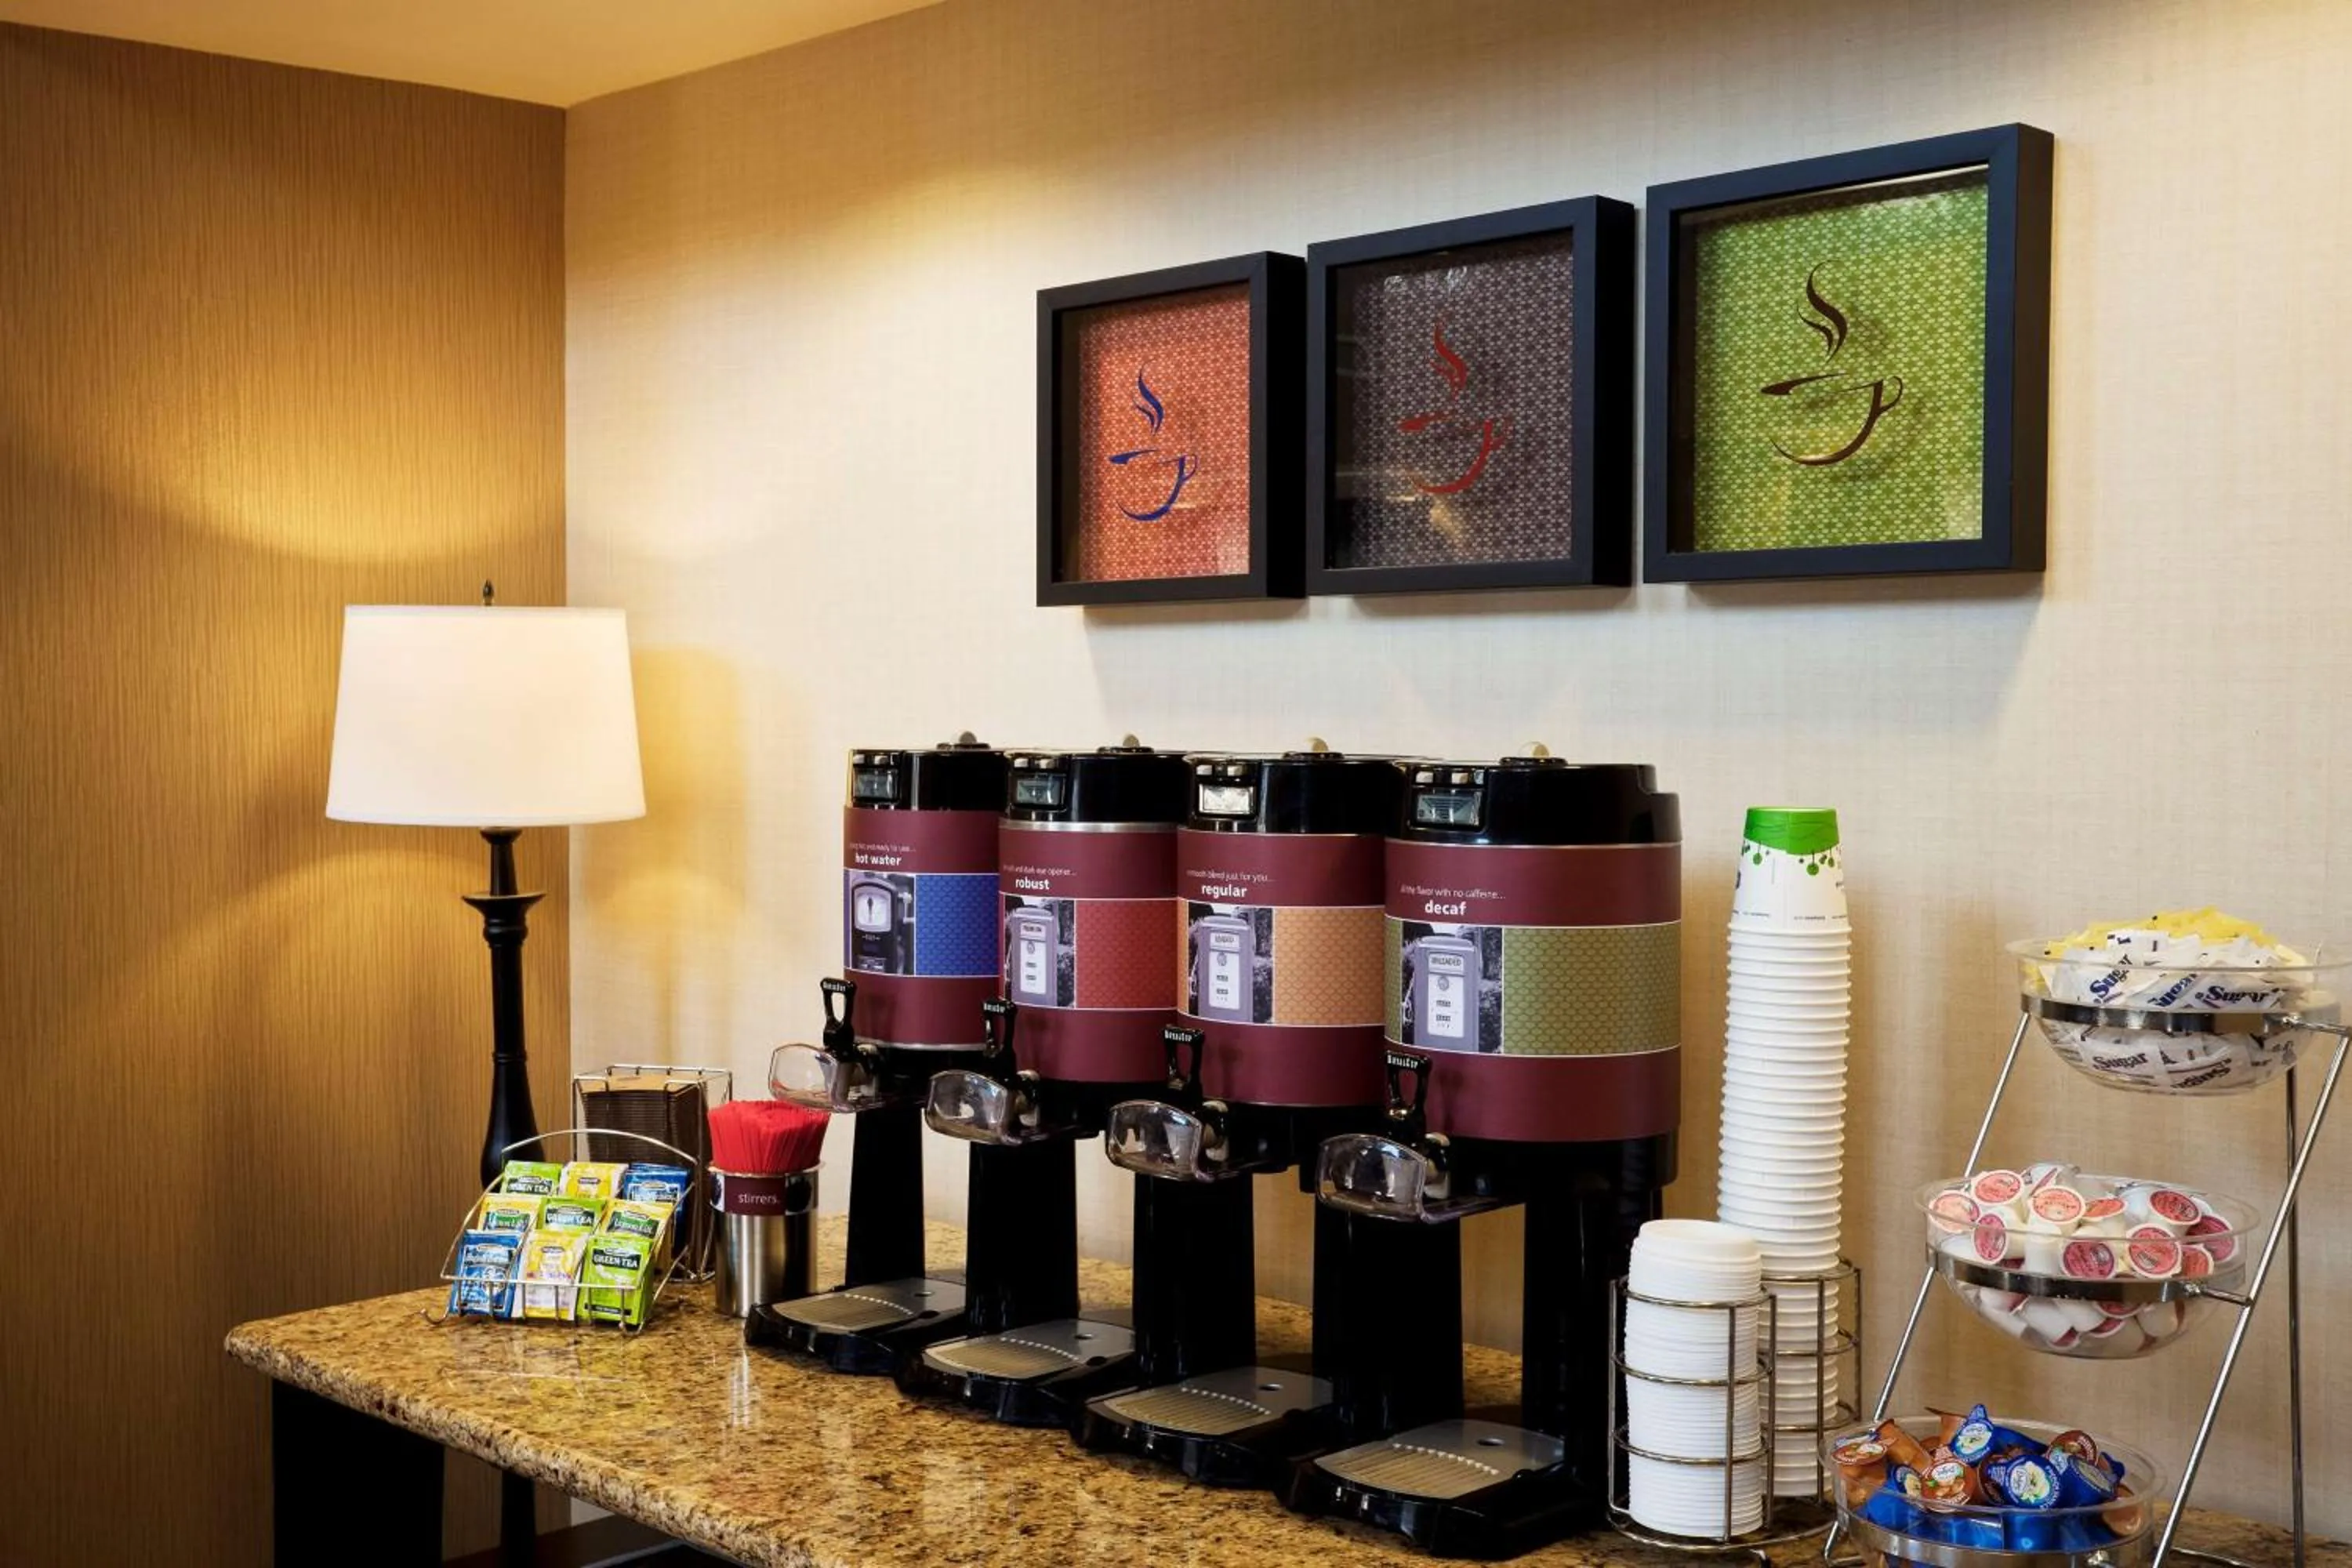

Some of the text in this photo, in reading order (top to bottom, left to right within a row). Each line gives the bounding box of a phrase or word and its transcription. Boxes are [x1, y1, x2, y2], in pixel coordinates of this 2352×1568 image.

[855, 852, 902, 866] hot water
[1015, 877, 1050, 890] robust
[1201, 884, 1247, 899] regular
[1425, 899, 1468, 916] decaf
[2207, 985, 2270, 1004] Sugar
[738, 1192, 778, 1205] stirrers
[622, 1258, 638, 1269] TEA
